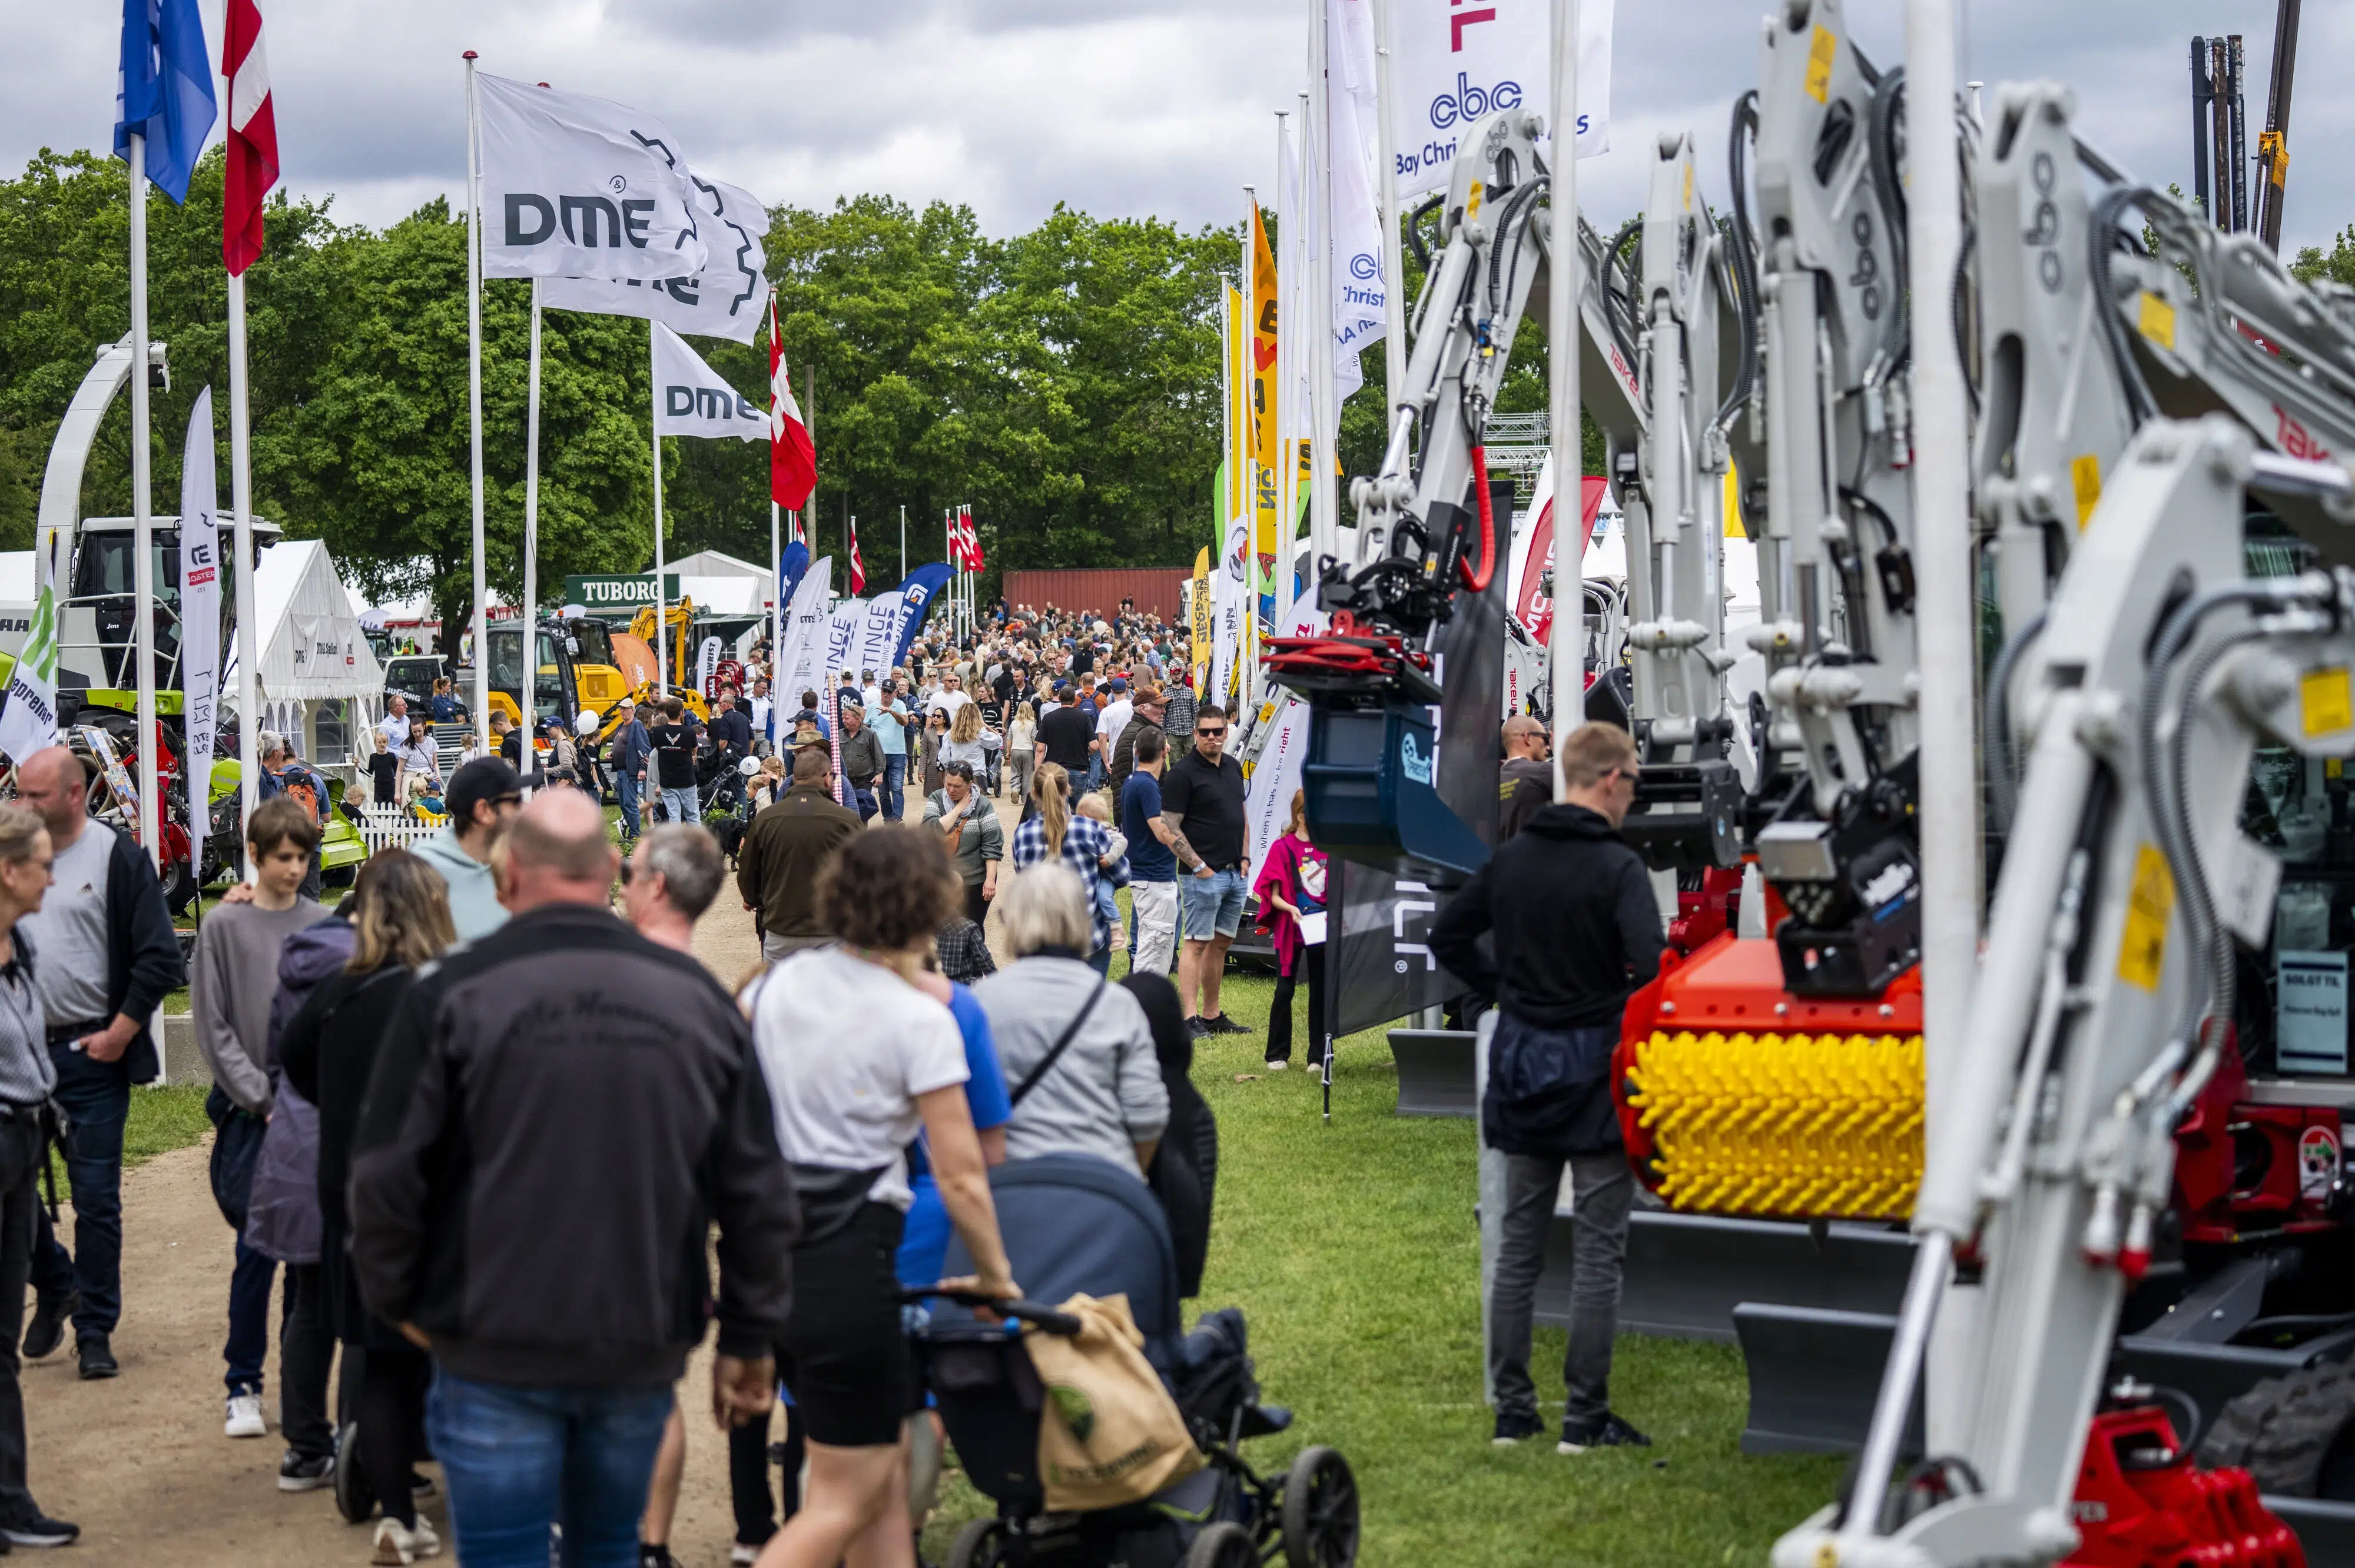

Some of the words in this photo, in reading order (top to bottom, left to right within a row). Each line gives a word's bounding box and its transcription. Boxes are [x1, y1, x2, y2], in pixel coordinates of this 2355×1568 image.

[1430, 71, 1523, 129] cbc
[505, 193, 655, 248] DME
[666, 386, 759, 421] DME
[1261, 819, 1270, 849] When
[1267, 789, 1276, 806] has
[1279, 726, 1291, 753] right
